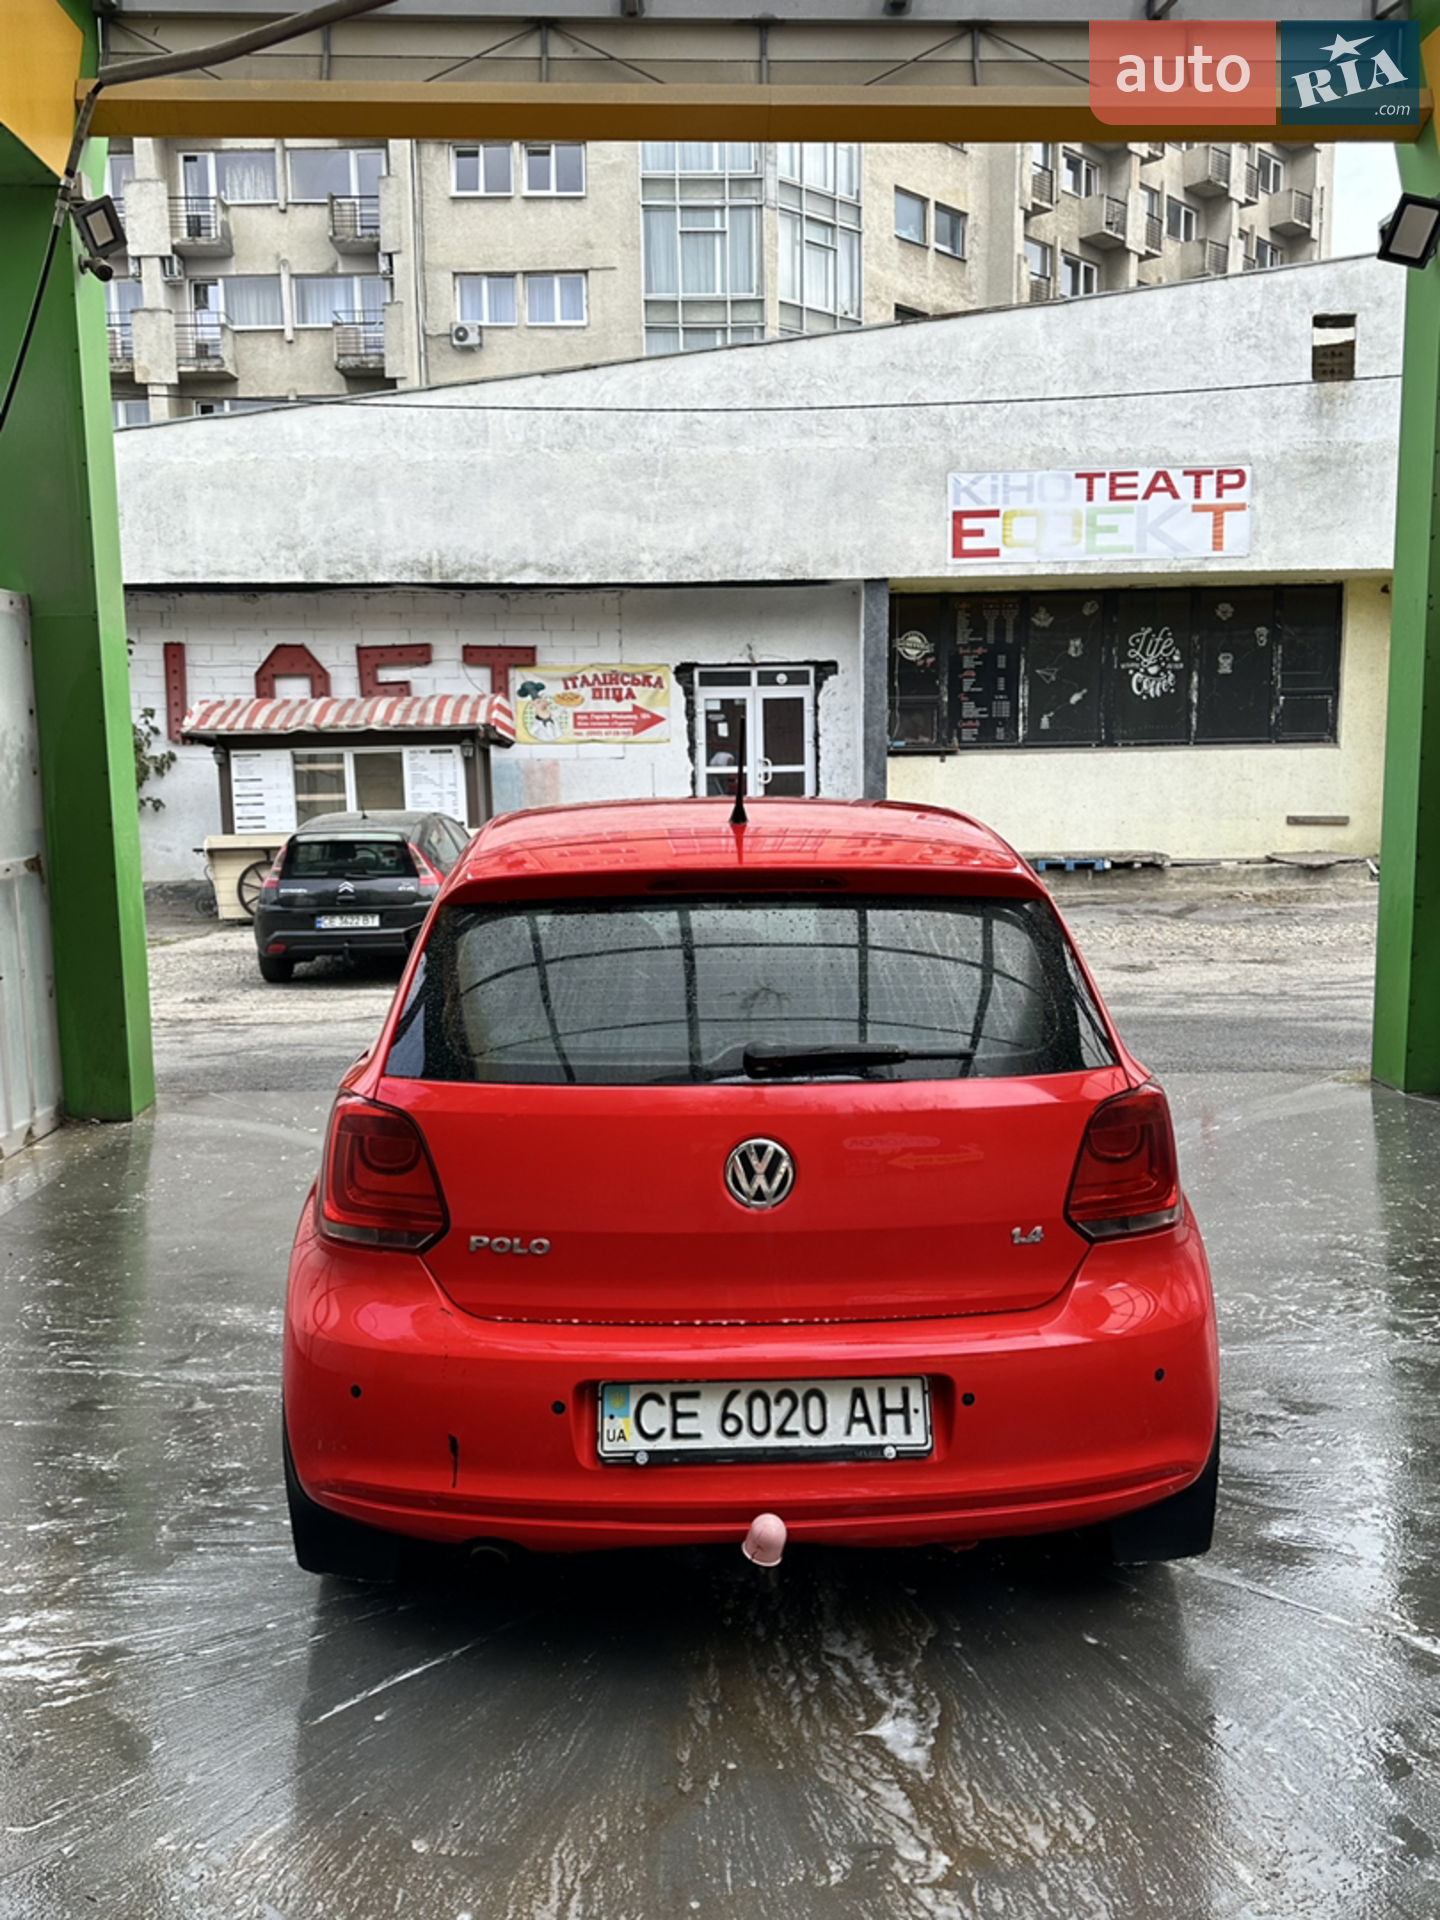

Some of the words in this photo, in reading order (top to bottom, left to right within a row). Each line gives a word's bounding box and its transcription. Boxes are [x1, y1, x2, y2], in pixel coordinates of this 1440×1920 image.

[1127, 626, 1176, 667] Life
[562, 669, 665, 690] ІТАЛІЙСЬКА
[1131, 671, 1176, 698] Coffee
[592, 687, 637, 703] ПІЦА
[1012, 1225, 1044, 1244] 1.4
[469, 1235, 551, 1255] POLO
[634, 1390, 702, 1442] CE
[720, 1387, 828, 1439] 6020
[845, 1386, 912, 1436] AH
[606, 1429, 627, 1442] UA
